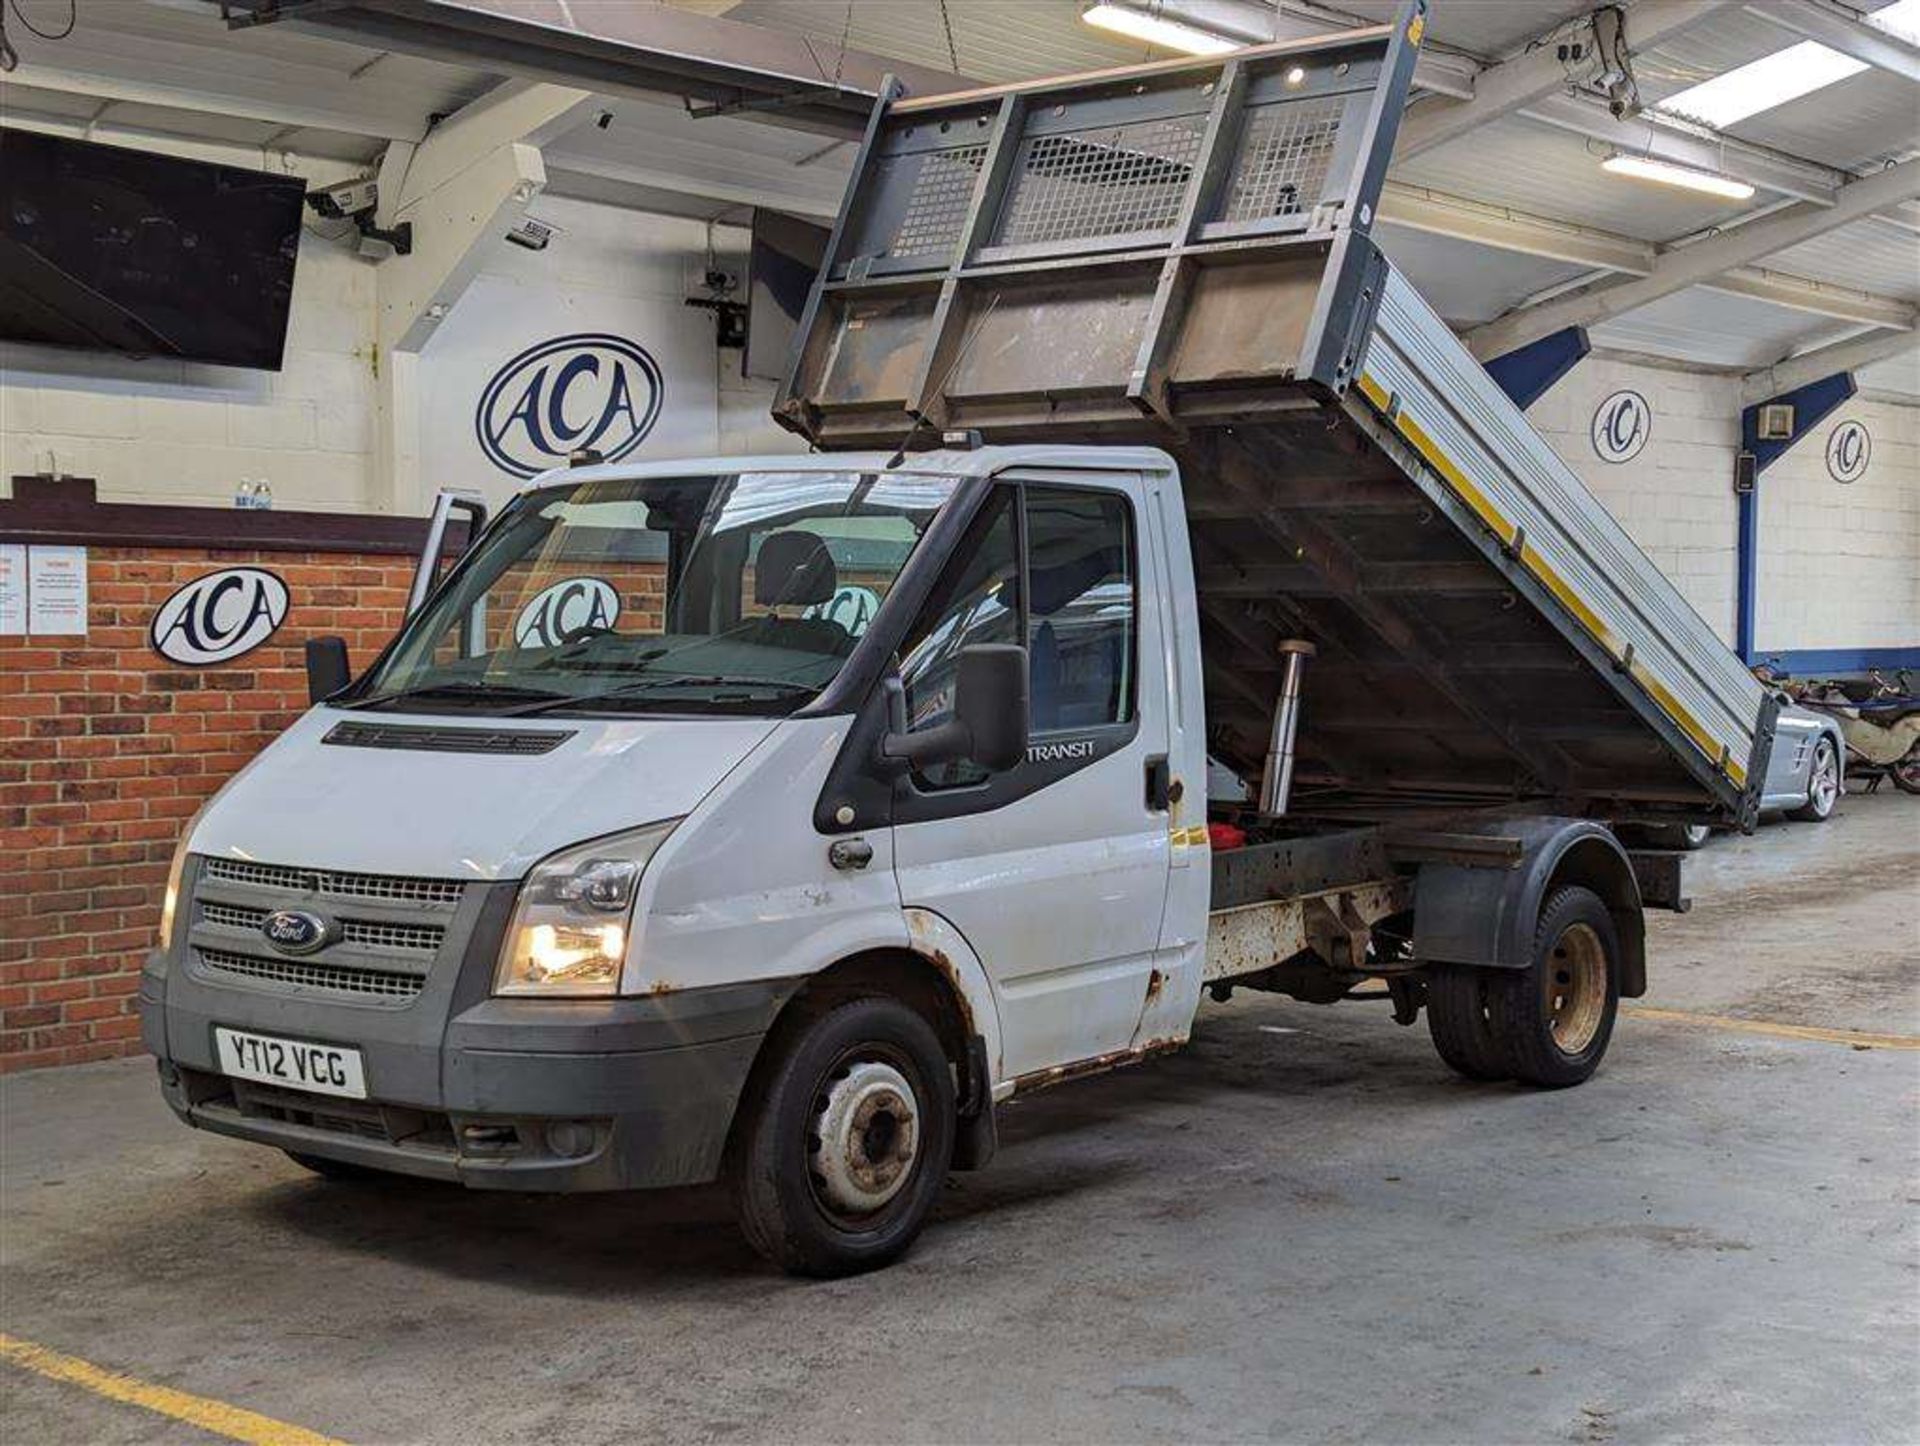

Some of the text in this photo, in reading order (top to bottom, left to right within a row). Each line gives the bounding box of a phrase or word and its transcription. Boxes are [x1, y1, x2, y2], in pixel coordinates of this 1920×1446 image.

[493, 353, 641, 456] ACA
[1596, 398, 1642, 453] ACA
[1830, 428, 1865, 474] ACA
[158, 575, 276, 652] ACA
[518, 583, 609, 649] ACA
[1026, 741, 1094, 762] TRANSIT
[270, 915, 307, 941] Ford
[231, 1035, 346, 1087] YT12 VCG
